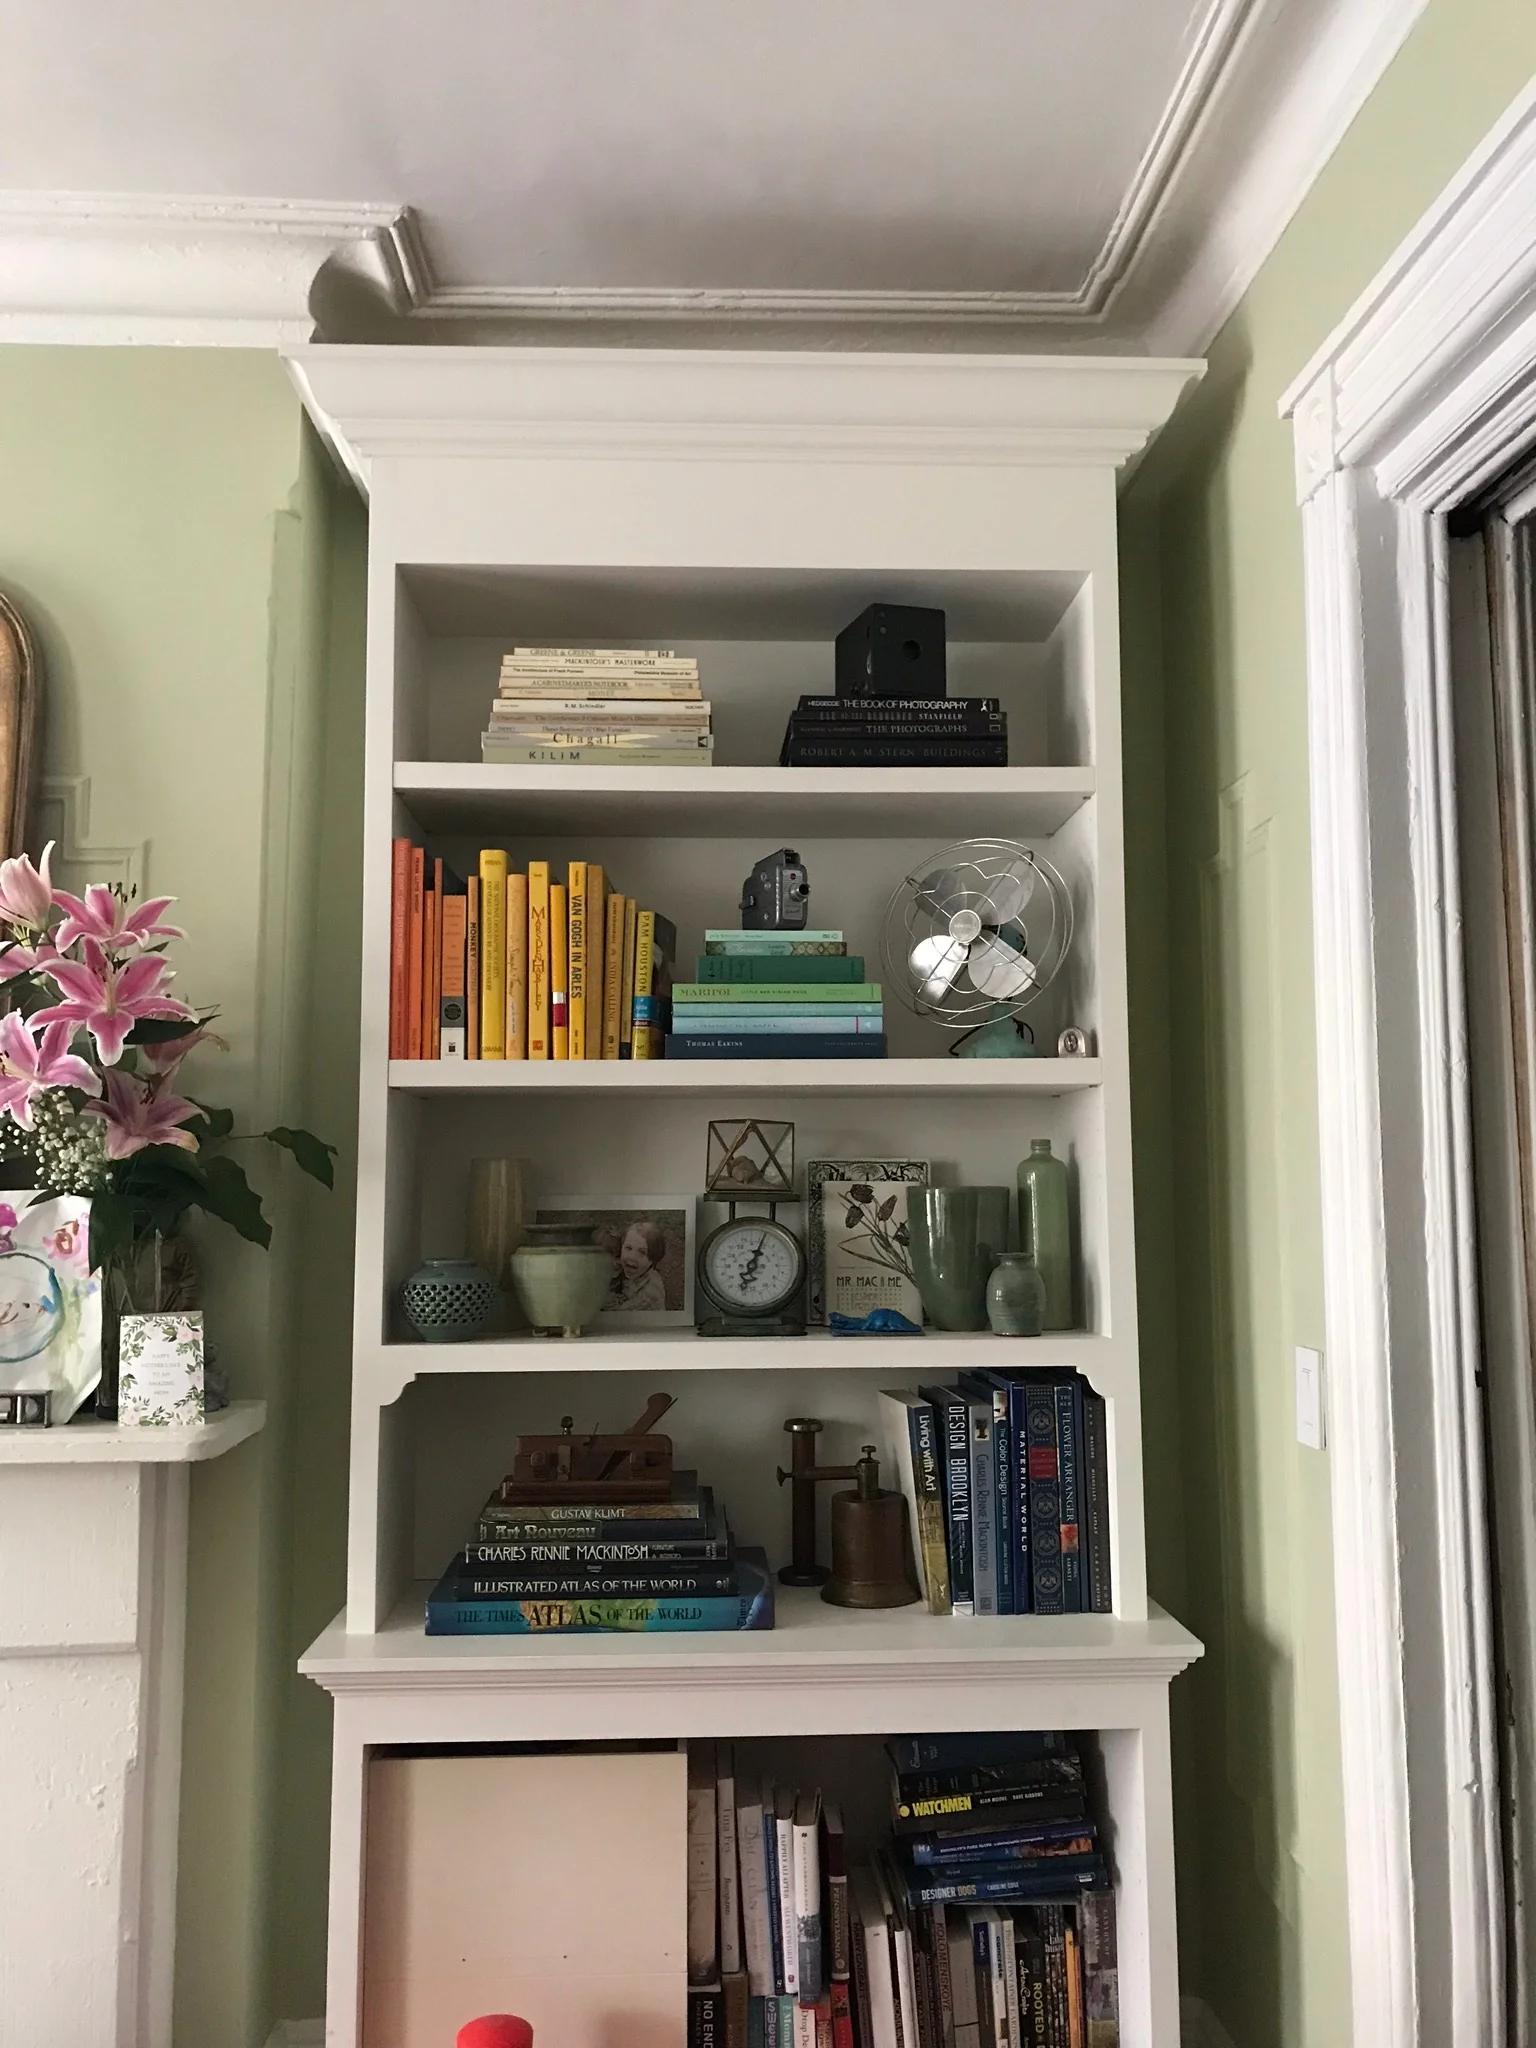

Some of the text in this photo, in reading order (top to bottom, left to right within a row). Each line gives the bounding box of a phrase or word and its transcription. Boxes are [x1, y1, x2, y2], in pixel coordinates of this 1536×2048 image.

[843, 699, 860, 708] THE
[861, 699, 885, 708] BOOK
[886, 700, 898, 708] OF
[899, 700, 968, 710] PHOTOGRAPHY
[553, 732, 618, 746] Chagall
[890, 724, 968, 733] PHOTOGRAPHS
[529, 751, 580, 760] KILIM
[641, 915, 650, 938] PAM
[571, 894, 582, 999] VAN GOGH IN ARLES
[639, 942, 649, 992] HOUSTON
[836, 1276, 902, 1287] MR MAC ME
[918, 1415, 937, 1491] Living with Art
[999, 1438, 1008, 1462] Color
[948, 1406, 969, 1521] DESIGN BROOKLYN
[1062, 1412, 1075, 1522] FLOWER ARRANGER
[998, 1464, 1009, 1495] Design
[1019, 1430, 1028, 1552] MATERIAL WORLD
[551, 1508, 626, 1519] GUSTAV KLIMT
[975, 1454, 990, 1572] CHARLES RENNIE MACKINTOSH
[495, 1524, 521, 1540] Art
[477, 1544, 649, 1561] CHARLES RENNIE MACKINTOSH
[474, 1579, 697, 1594] ILLUSTRATED ATLAS OF THE WORLD
[454, 1604, 702, 1627] THE TIMES ATLAS OF THE WORLD
[912, 1796, 973, 1817] WATCHMEN
[722, 1808, 733, 1832] Tina
[722, 1835, 734, 1854] Fey
[780, 1833, 788, 1862] HAPPILY
[782, 1876, 790, 1899] AFTER
[921, 1887, 957, 1901] DESIGNER
[957, 1884, 977, 1897] DOGS
[833, 1887, 842, 1959] PENNSYLVANIA
[978, 1930, 986, 1956] Sotheby's
[853, 1922, 866, 1999] MARY CASSATT
[936, 1922, 950, 2012] KOLOMENSKOYE
[996, 1935, 1004, 1979] concrete
[703, 2000, 714, 2020] NO
[1032, 1982, 1045, 2034] ROOTED
[800, 2010, 809, 2032] Drop
